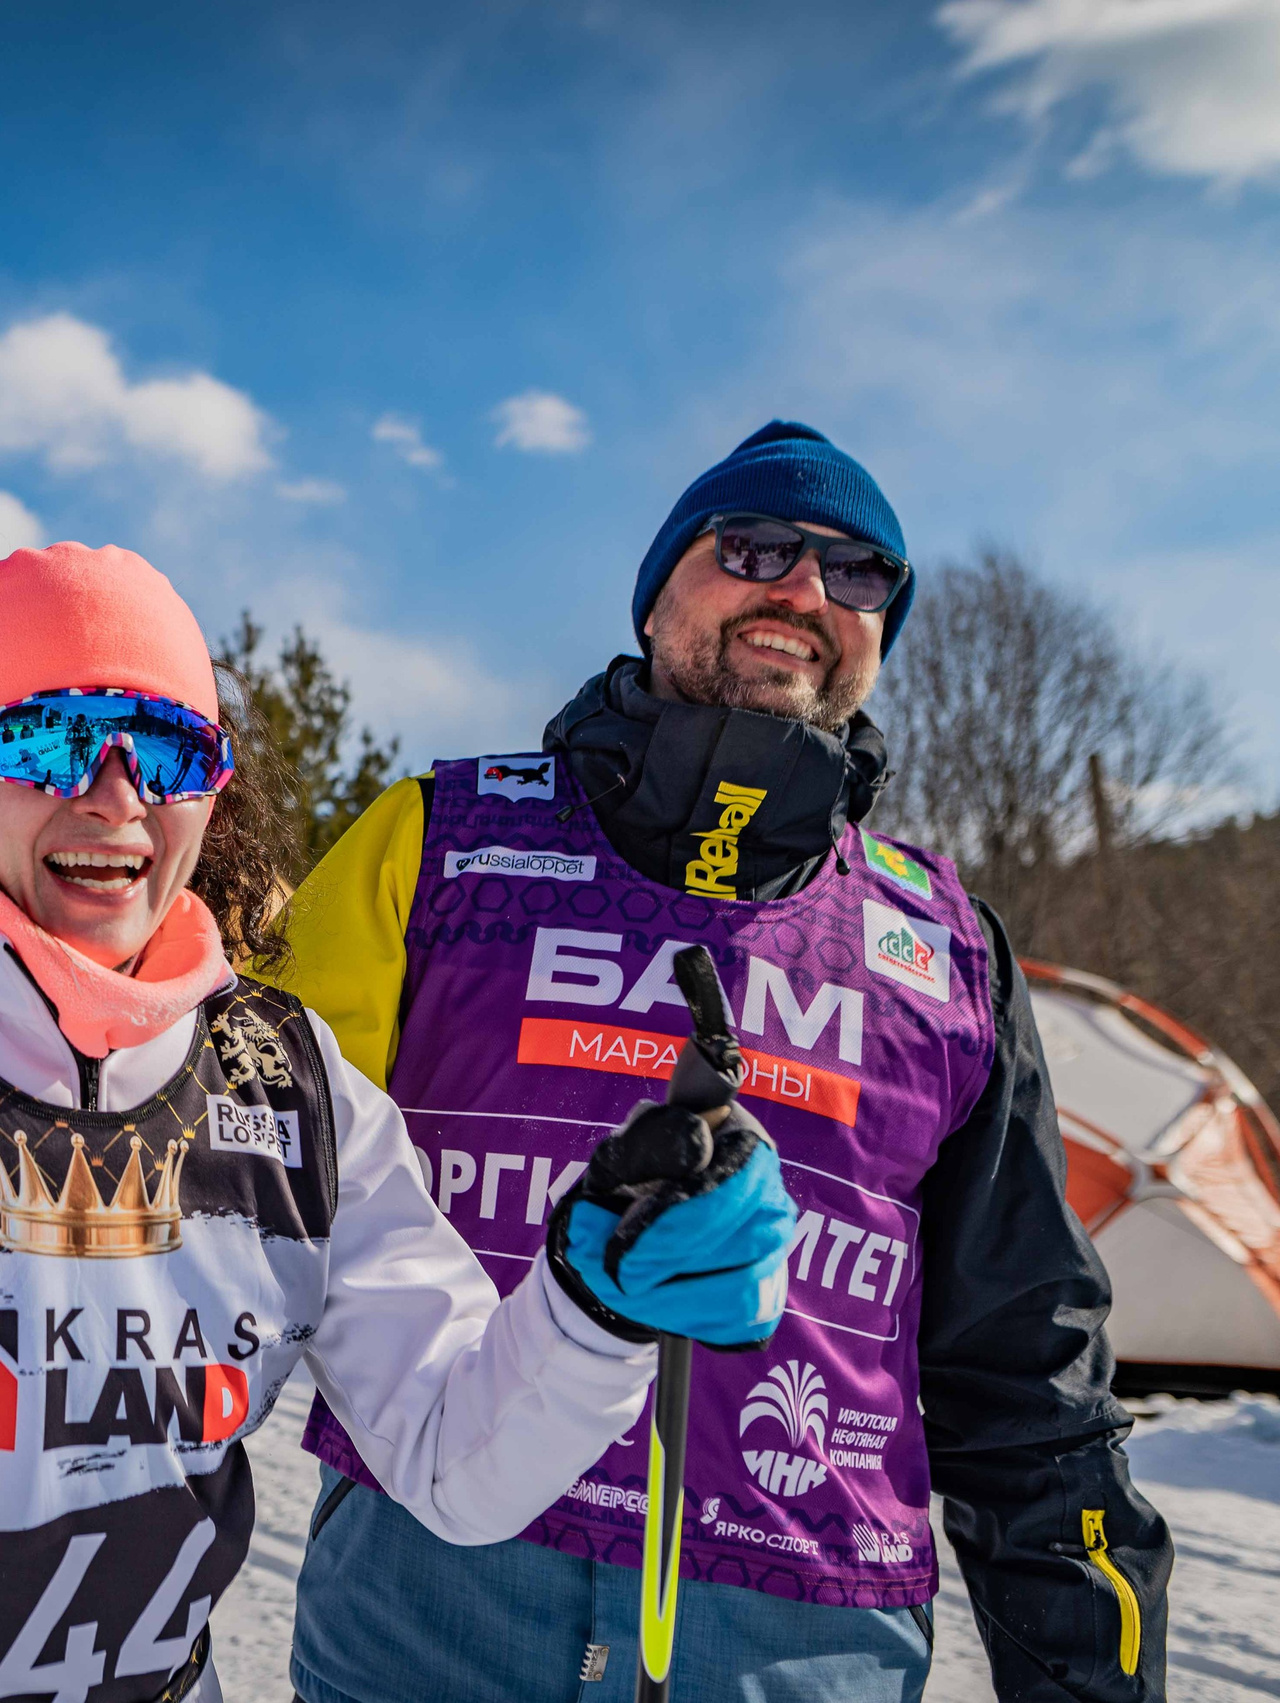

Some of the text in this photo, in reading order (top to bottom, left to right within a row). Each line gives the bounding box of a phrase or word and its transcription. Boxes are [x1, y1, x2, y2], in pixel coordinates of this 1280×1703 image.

[471, 853, 585, 875] russialoppet
[525, 926, 865, 1067] БАМ
[569, 1029, 813, 1102] МАРАНЫ
[45, 1307, 260, 1362] KRAS
[43, 1363, 249, 1451] LAND
[837, 1407, 898, 1432] ИРКУТСКАЯ
[829, 1449, 882, 1470] КОМПАНИЯ
[831, 1428, 888, 1449] НЕФТЯНАЯ
[741, 1449, 829, 1498] ИНК
